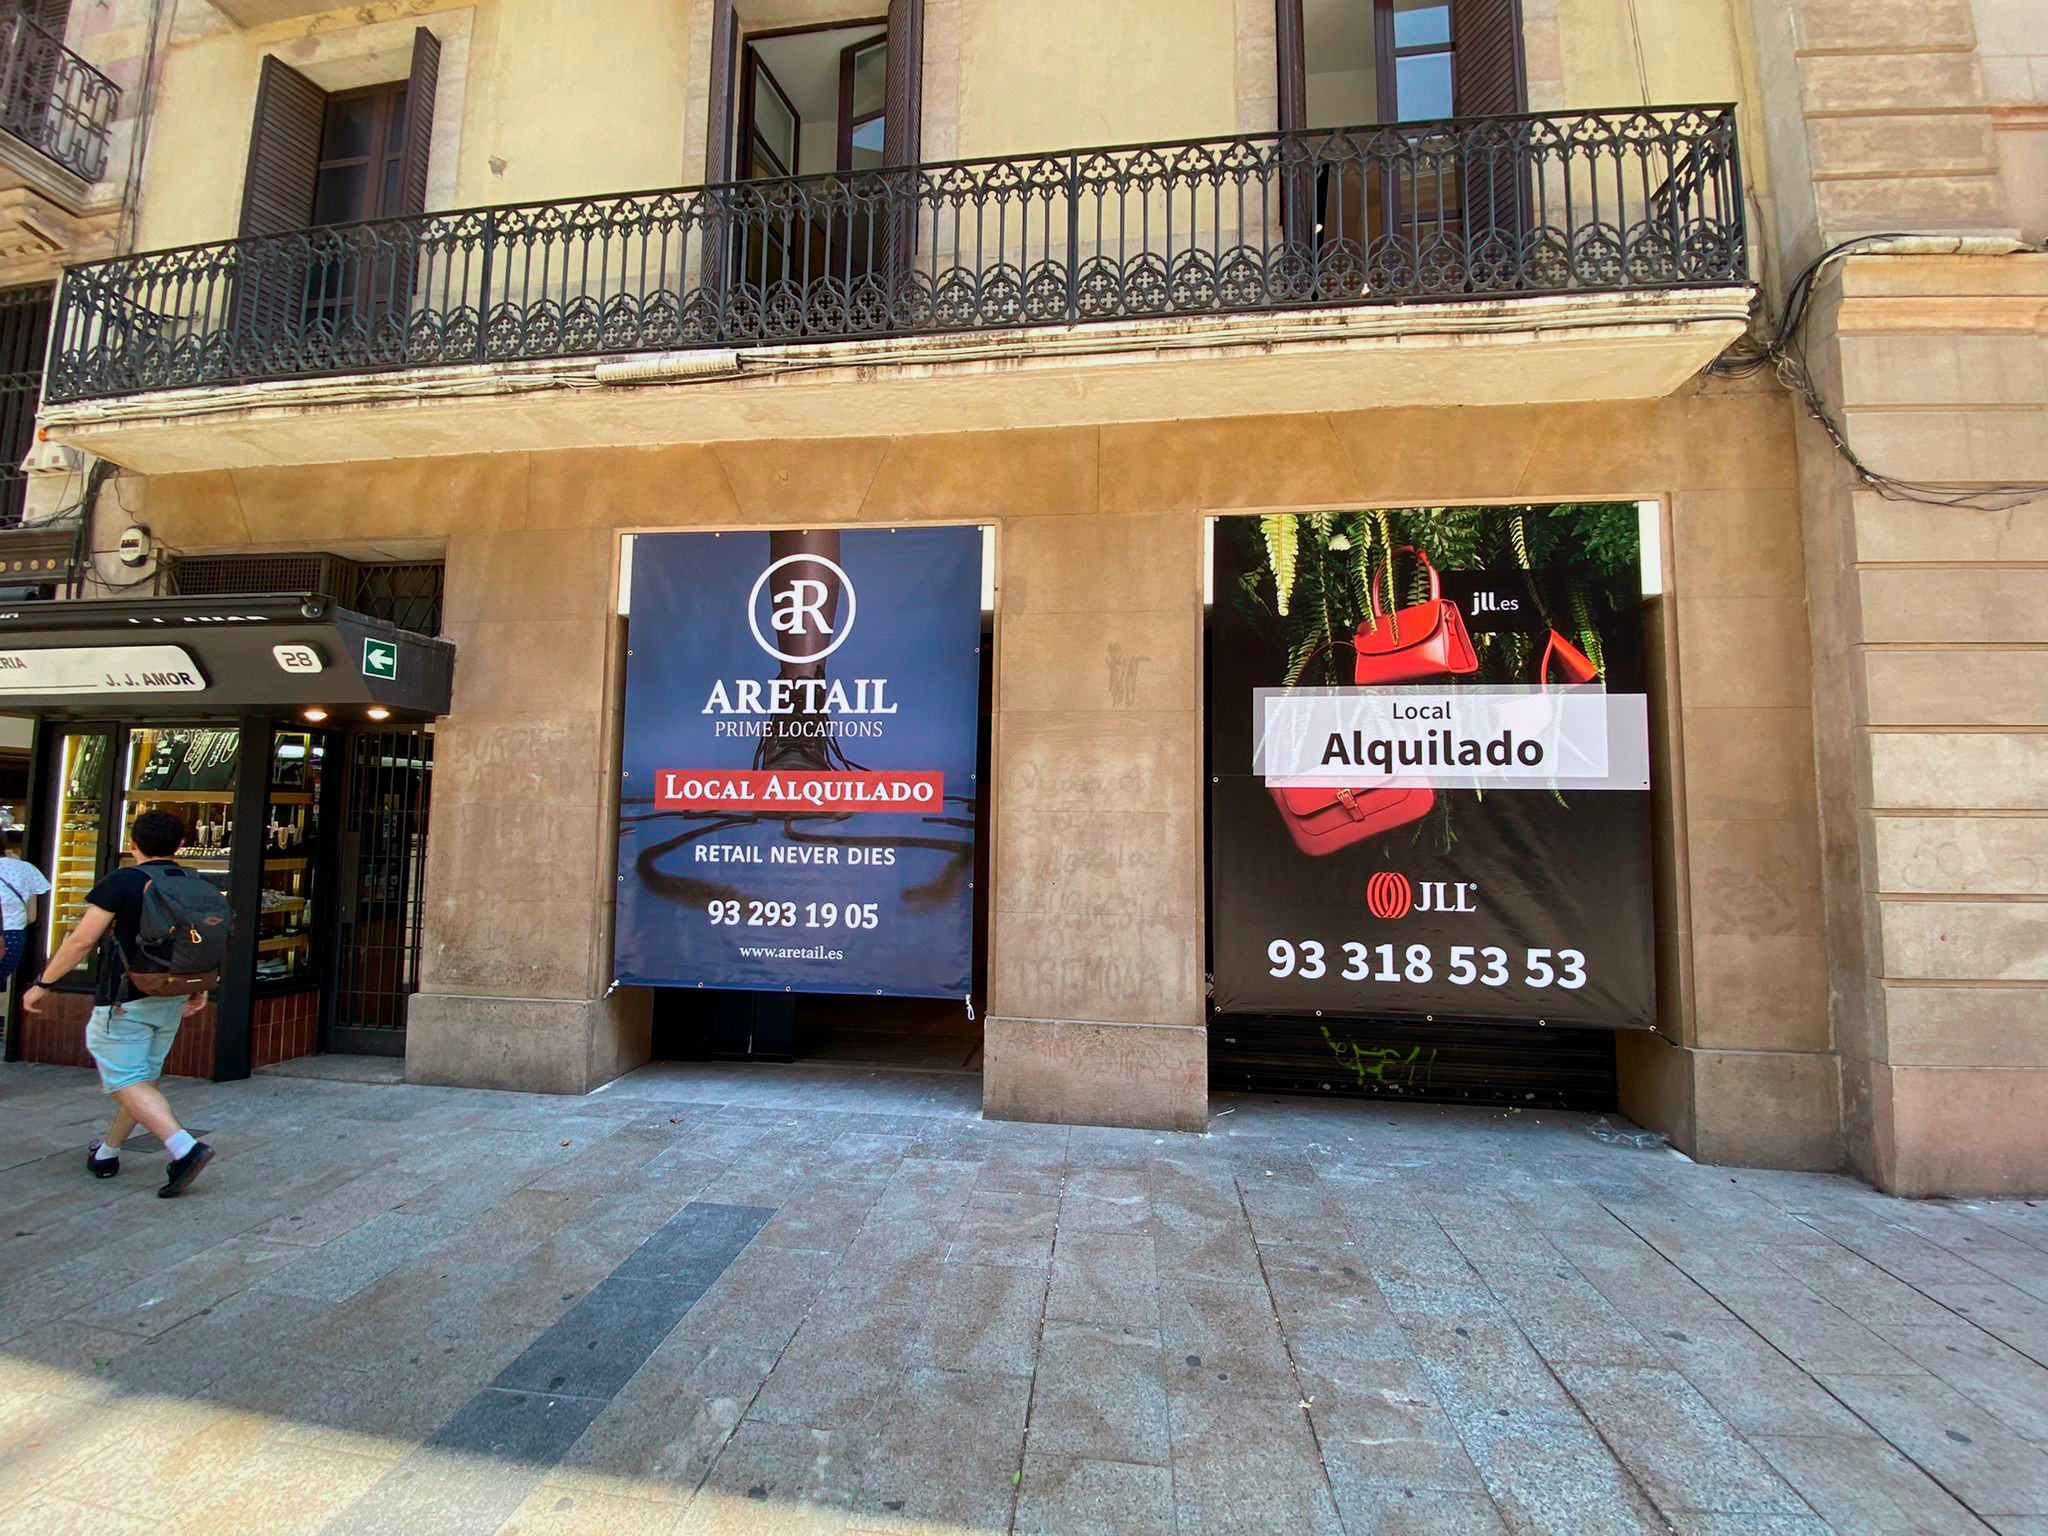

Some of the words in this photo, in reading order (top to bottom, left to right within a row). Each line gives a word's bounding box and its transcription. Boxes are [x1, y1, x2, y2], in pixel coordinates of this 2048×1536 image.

[1470, 591, 1519, 616] jll.es
[281, 652, 312, 667] 28
[106, 673, 120, 687] J.
[125, 673, 140, 687] J.
[143, 671, 195, 686] AMOR
[701, 678, 898, 715] ARETAIL
[1393, 701, 1451, 720] Local
[714, 719, 773, 738] PRIME
[778, 719, 883, 738] LOCATIONS
[1321, 729, 1544, 774] Alquilado
[664, 774, 756, 800] LOCAL
[762, 774, 934, 806] ALQUILADO
[695, 844, 764, 863] RETAIL
[770, 846, 839, 865] NEVER
[847, 847, 896, 866] DIES
[707, 900, 741, 926] 93
[747, 900, 797, 927] 293
[805, 902, 838, 928] 19
[844, 902, 879, 930] 05
[739, 945, 843, 961] www.aretail.es
[1267, 939, 1327, 979] 93
[1341, 941, 1433, 984] 318
[1447, 945, 1509, 987] 53
[1524, 948, 1587, 989] 53
